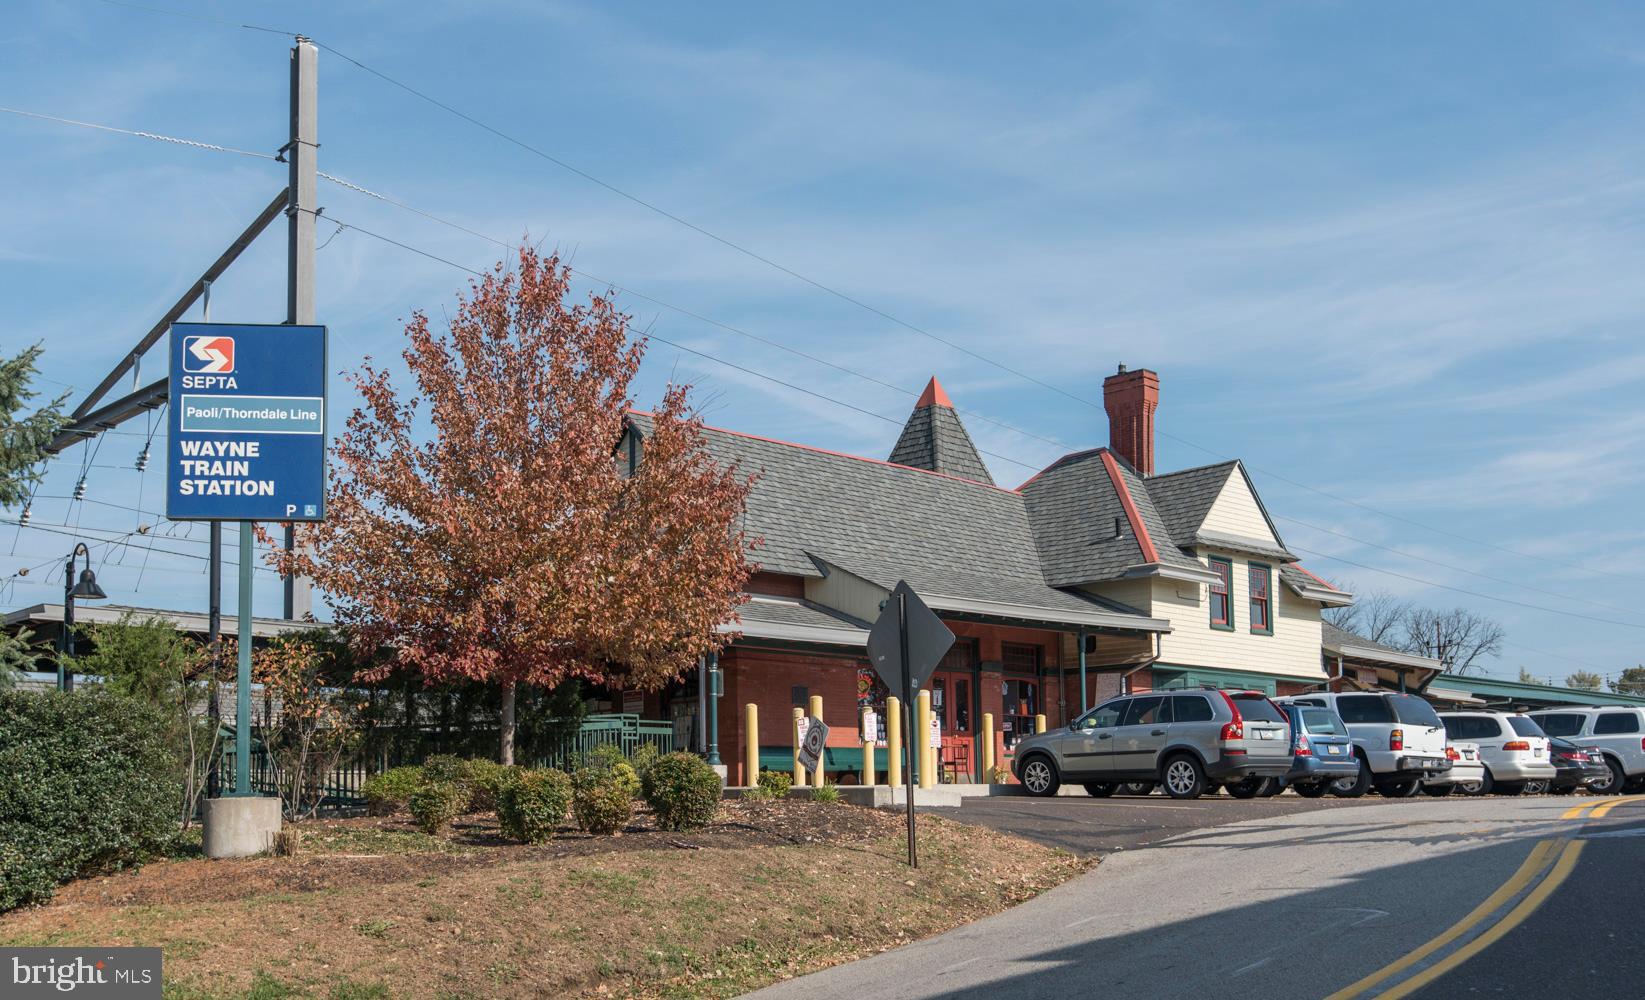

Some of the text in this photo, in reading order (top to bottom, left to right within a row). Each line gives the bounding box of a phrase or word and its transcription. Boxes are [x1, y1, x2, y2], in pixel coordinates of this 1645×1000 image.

[182, 376, 238, 389] SEPTA
[187, 407, 317, 420] Paoli/Thorndale Line
[180, 441, 260, 457] WAYNE
[180, 460, 249, 476] TRAIN
[179, 480, 275, 496] STATION
[286, 504, 297, 517] P
